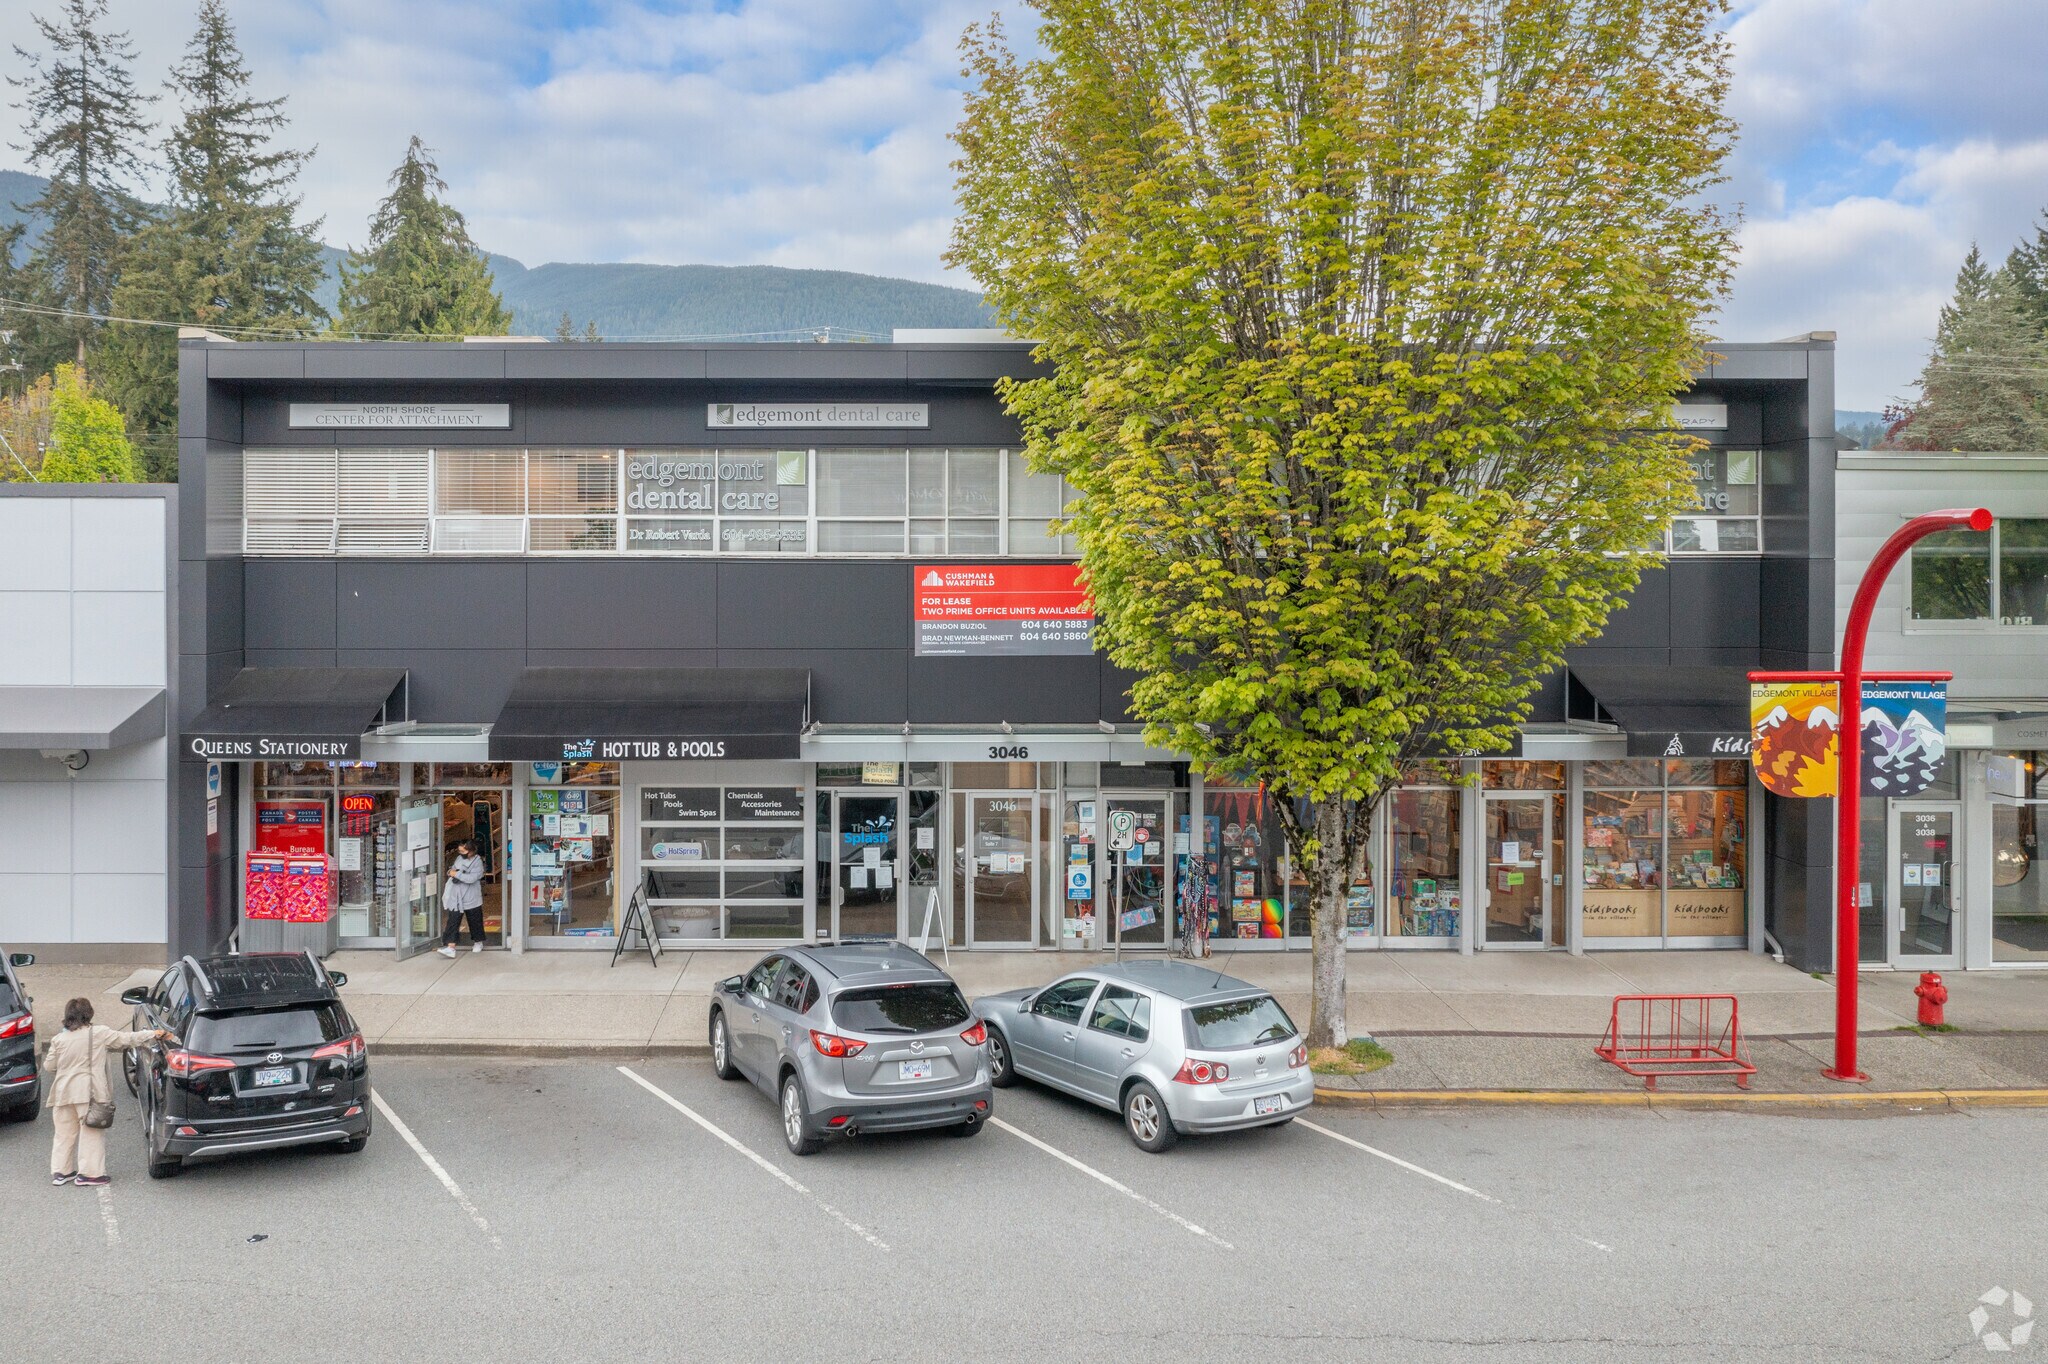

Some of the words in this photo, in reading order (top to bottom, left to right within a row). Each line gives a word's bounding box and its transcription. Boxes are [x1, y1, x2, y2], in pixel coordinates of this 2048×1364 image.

[316, 415, 365, 425] CENTER
[369, 415, 394, 425] FOR
[397, 415, 483, 425] ATTACHMENT
[736, 406, 822, 426] edgemont
[827, 406, 880, 422] dental
[885, 410, 921, 422] care
[627, 454, 764, 487] edgemont
[627, 483, 712, 510] dental
[722, 491, 779, 510] care
[629, 529, 644, 540] Dr
[645, 528, 680, 540] Robert
[922, 607, 944, 615] TWO
[946, 607, 973, 615] PRIME
[975, 607, 1008, 615] OFFICE
[1010, 607, 1036, 615] UNITS
[1021, 620, 1040, 629] 604
[1043, 620, 1062, 629] 640
[1064, 620, 1088, 629] 5883
[1020, 632, 1039, 641] 604
[1041, 632, 1061, 641] 640
[1063, 632, 1088, 641] 5860
[1752, 689, 1800, 698] EDGEMONT
[1802, 689, 1837, 697] VILLAGE
[1861, 690, 1910, 699] EDGEMONT
[1910, 691, 1946, 699] VILLAGE
[603, 742, 631, 758] HOT
[633, 742, 660, 758] TUB
[667, 742, 678, 757] &
[681, 741, 725, 757] POOLS
[988, 746, 1029, 759] 3046
[563, 750, 592, 759] Splash
[344, 797, 373, 810] OPEN
[663, 800, 683, 808] Pools
[741, 800, 782, 808] Accessories
[989, 800, 1017, 812] 3046
[678, 809, 699, 817] Swim
[699, 809, 717, 817] Spas
[754, 809, 800, 817] Maintenance
[1120, 818, 1127, 827] P
[1915, 814, 1936, 822] 3036
[851, 823, 870, 832] The
[844, 832, 889, 846] Splash
[261, 845, 278, 853] Post
[289, 845, 316, 853] Bureau
[668, 847, 700, 856] HotSpring
[1582, 904, 1638, 914] kidsbooks
[1674, 904, 1730, 914] kidsbooks
